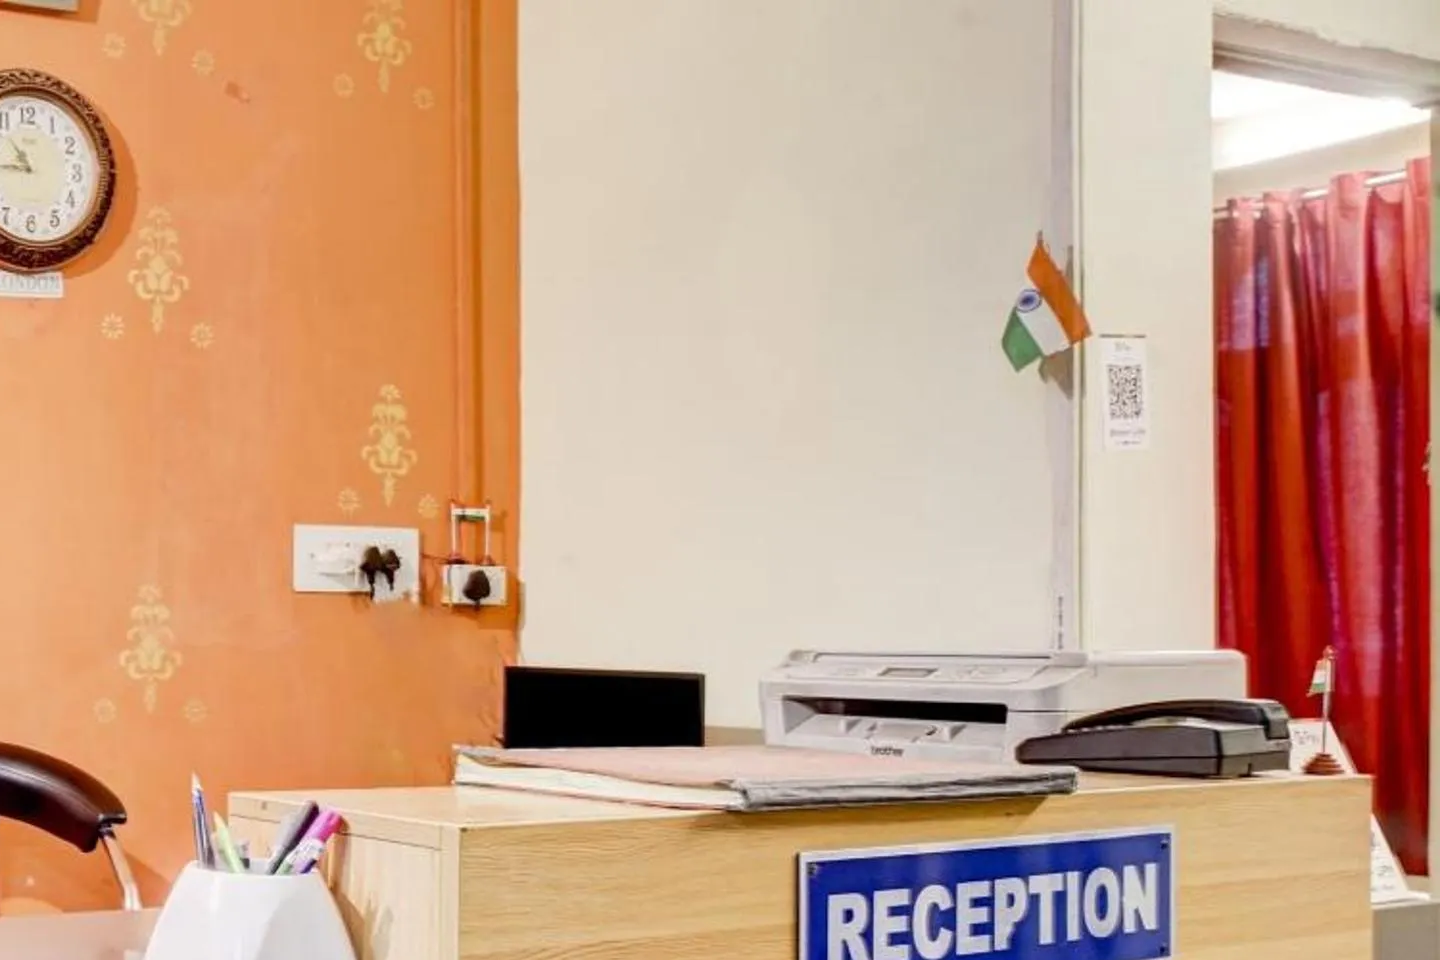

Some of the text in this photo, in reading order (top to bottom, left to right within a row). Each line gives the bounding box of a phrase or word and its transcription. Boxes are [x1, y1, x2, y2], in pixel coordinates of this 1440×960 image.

[19, 106, 36, 125] 12
[49, 117, 56, 135] 1
[65, 136, 75, 156] 2
[71, 164, 83, 183] 3
[65, 189, 75, 208] 4
[1, 207, 10, 226] 7
[25, 214, 36, 233] 6
[49, 209, 60, 228] 5
